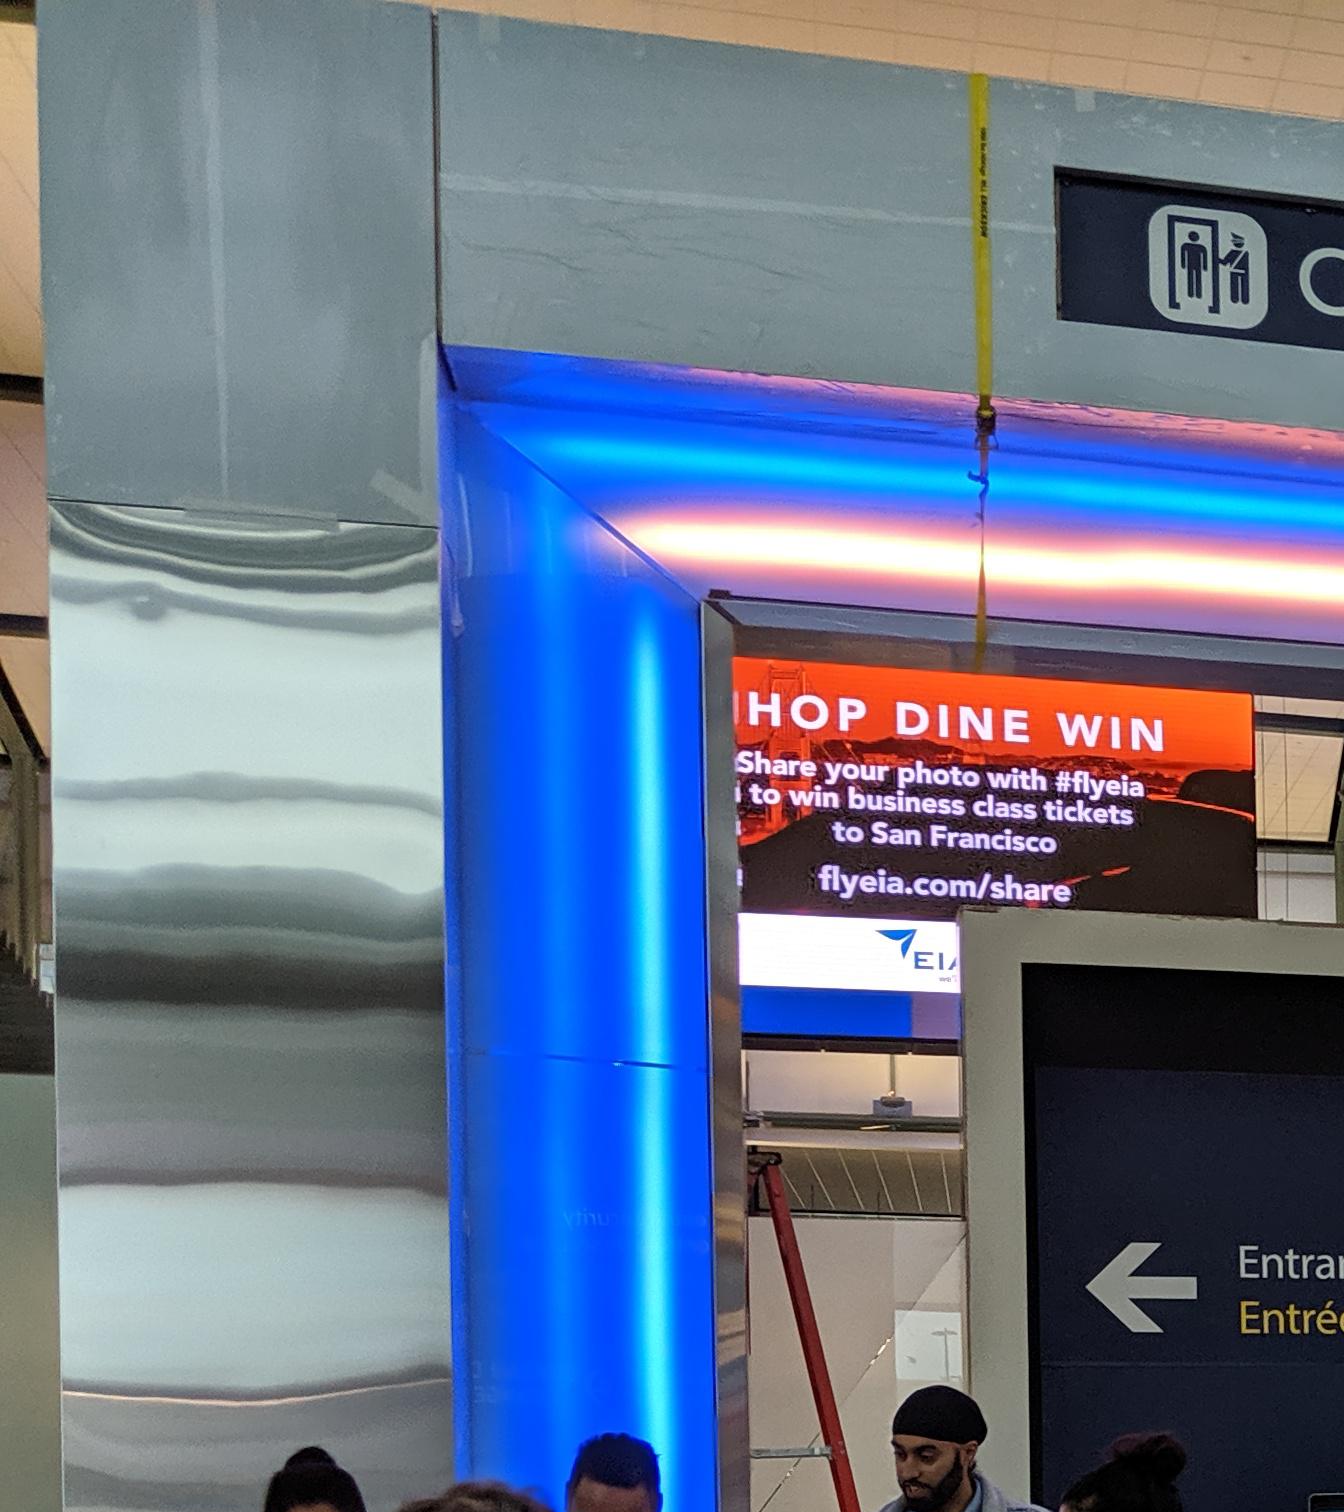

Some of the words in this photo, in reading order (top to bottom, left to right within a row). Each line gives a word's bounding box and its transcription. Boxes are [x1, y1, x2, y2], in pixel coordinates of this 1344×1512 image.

[735, 691, 867, 732] HOP
[896, 702, 1030, 743] DINE
[1056, 712, 1164, 752] WIN
[736, 751, 817, 777] Share
[825, 762, 889, 785] your
[898, 760, 980, 788] photo
[987, 768, 1047, 791] with
[1055, 770, 1145, 801] #flyeia
[749, 783, 781, 804] to
[788, 785, 840, 809] win
[848, 786, 967, 816] business
[972, 794, 1038, 820] class
[1043, 799, 1134, 826] tickets
[832, 821, 865, 842] to
[871, 822, 922, 846] San
[930, 825, 1058, 853] Francisco
[818, 864, 1072, 903] flyeia.com/share
